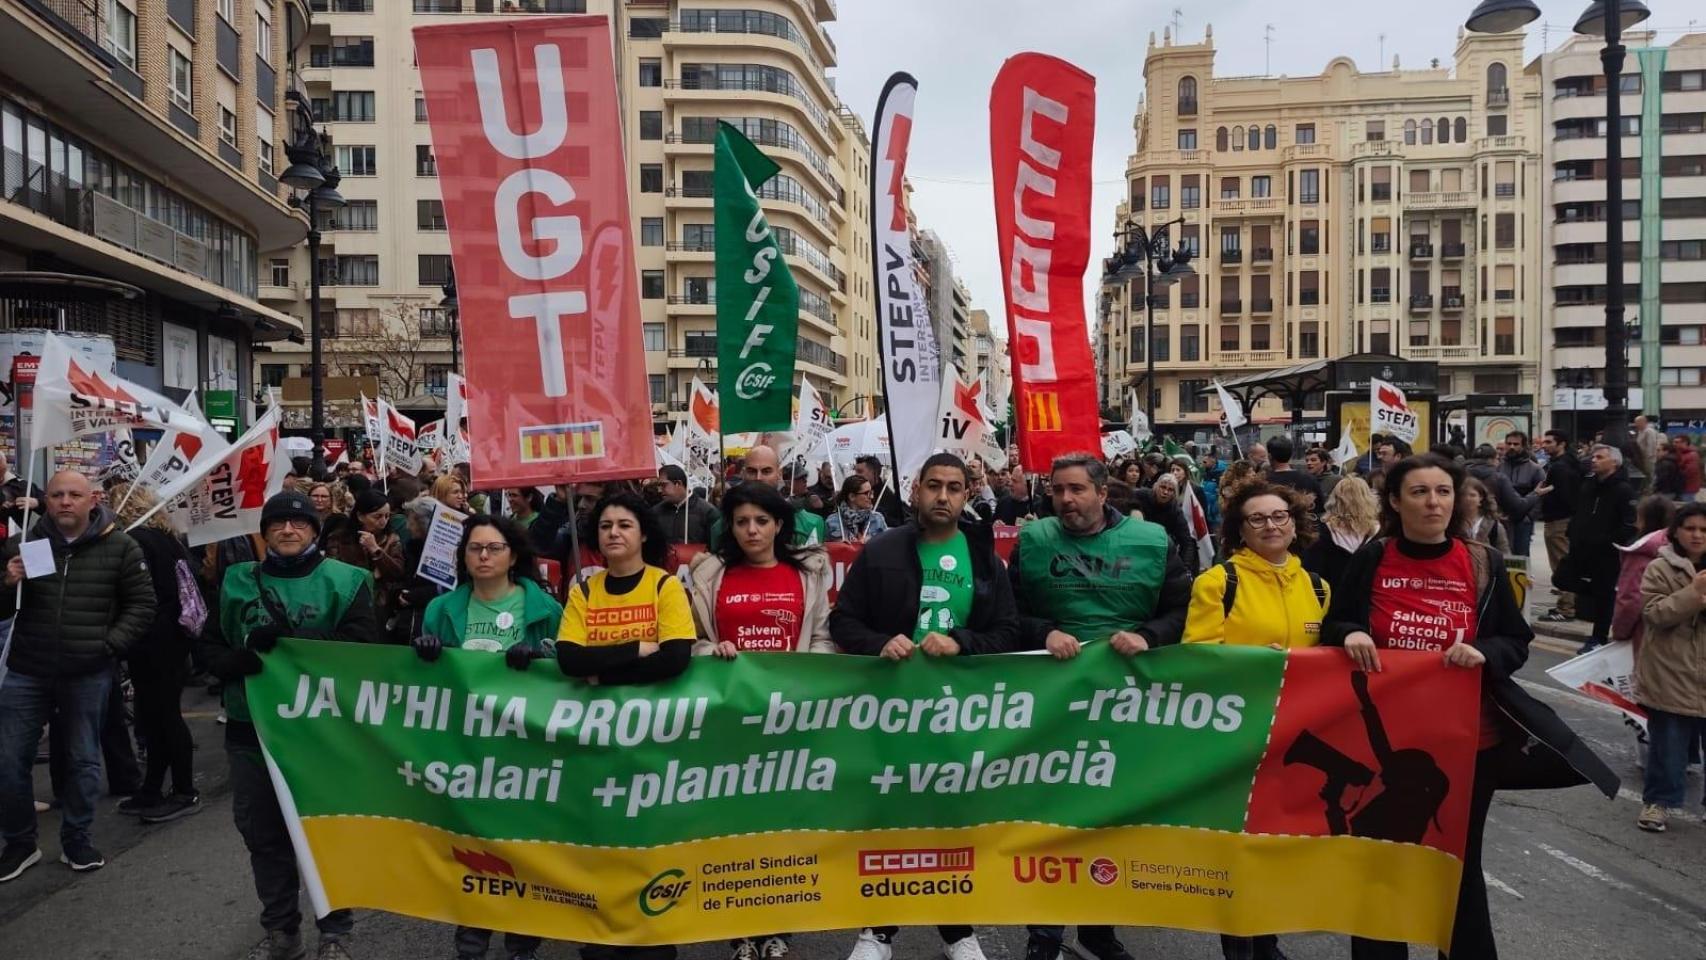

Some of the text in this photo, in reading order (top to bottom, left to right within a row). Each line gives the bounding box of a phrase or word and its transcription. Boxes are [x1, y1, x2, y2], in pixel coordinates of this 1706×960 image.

[470, 43, 587, 398] UGT
[1011, 86, 1069, 384] CCOO
[885, 243, 916, 383] STEPV
[594, 318, 606, 380] TEPV
[388, 435, 418, 458] TEPV
[209, 462, 238, 519] STEPV
[1382, 578, 1409, 588] UGT
[726, 593, 749, 604] UGT
[1393, 610, 1447, 625] Salvem
[588, 622, 657, 641] ducació
[737, 625, 781, 636] Salvem
[1390, 622, 1448, 639] l'escola
[737, 637, 782, 648] l'escola
[277, 673, 1246, 747] JA N'HI HA PROU! -burocràcia -ràtios
[397, 740, 1117, 818] +salari +plantilla +valencià
[702, 854, 818, 875] Central Sindical
[865, 853, 938, 870] CCOO
[1013, 856, 1083, 884] UGT
[1131, 860, 1230, 881] Ensenyament
[462, 875, 527, 898] STEPV
[531, 883, 598, 902] INTERSINDICAL
[702, 872, 819, 892] Independiente y
[860, 874, 974, 898] educació
[1131, 879, 1234, 899] Serveis Públics PV
[543, 893, 598, 911] VALENCIANA
[703, 890, 822, 911] de Funcionarios
